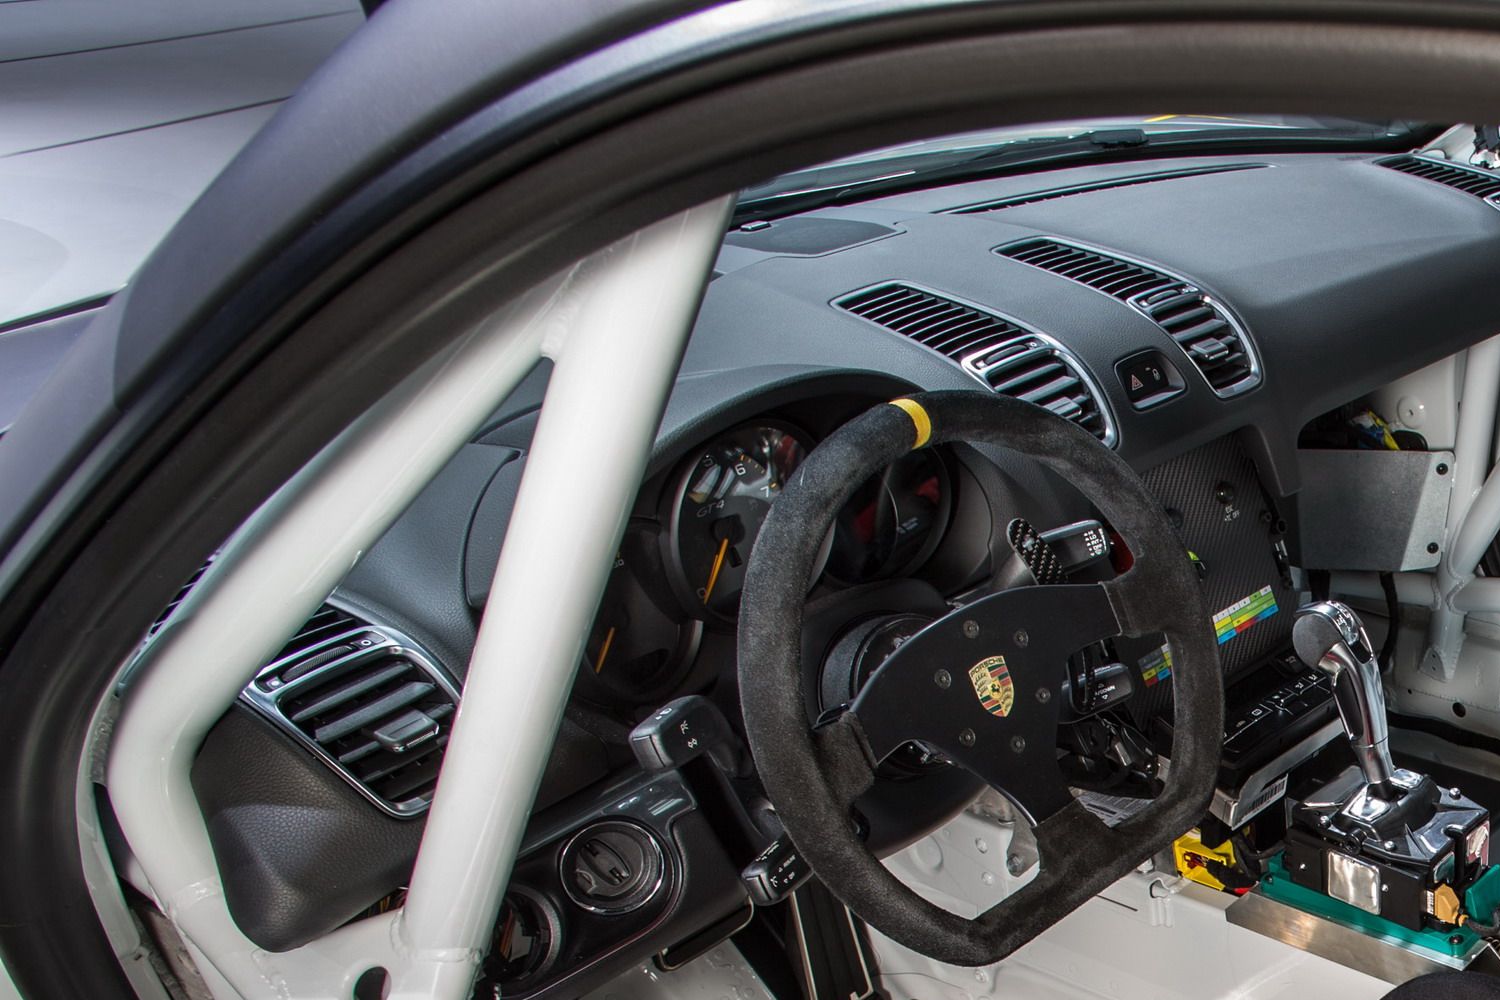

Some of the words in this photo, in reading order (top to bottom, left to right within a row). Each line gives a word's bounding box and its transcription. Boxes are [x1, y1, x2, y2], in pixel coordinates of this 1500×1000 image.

[734, 463, 746, 476] 6
[760, 485, 770, 498] 7
[696, 499, 726, 518] GT4
[969, 656, 1004, 678] PORSCHE
